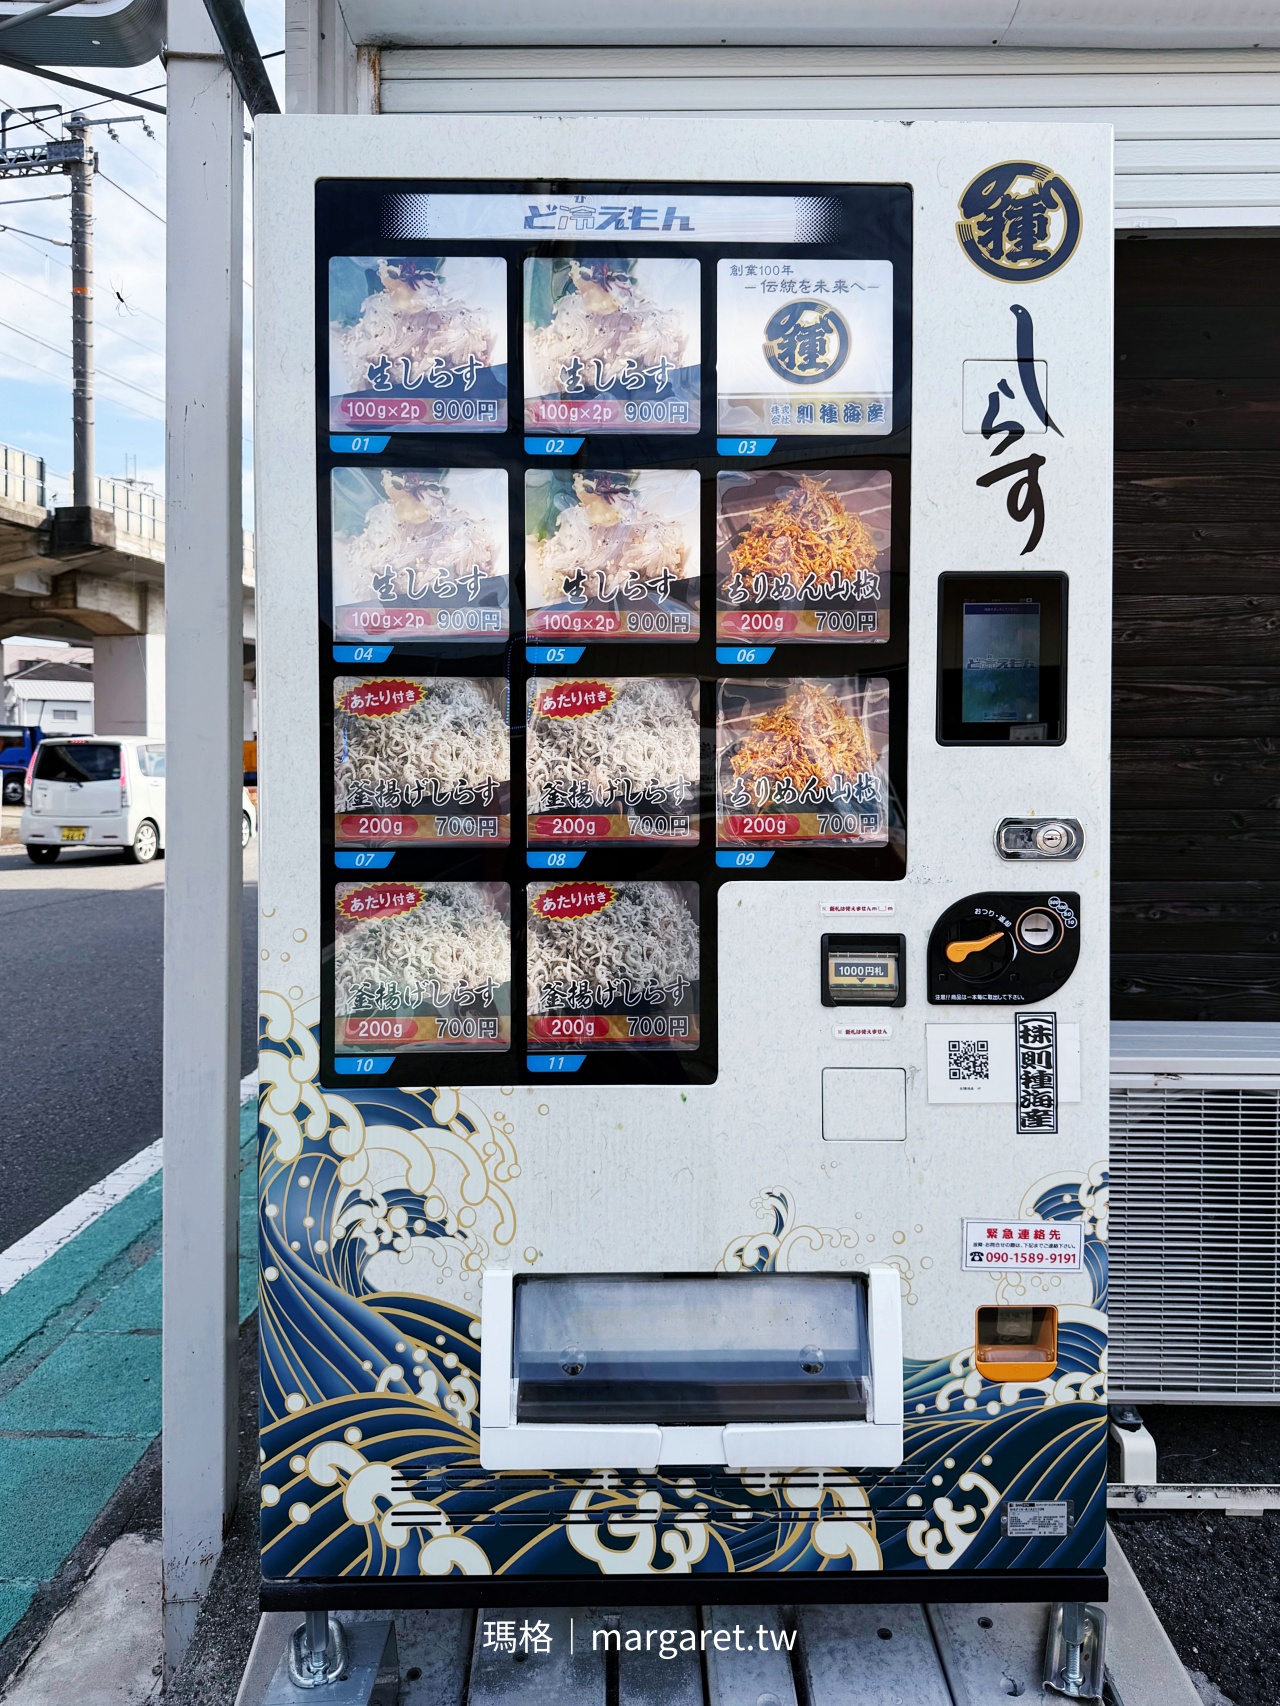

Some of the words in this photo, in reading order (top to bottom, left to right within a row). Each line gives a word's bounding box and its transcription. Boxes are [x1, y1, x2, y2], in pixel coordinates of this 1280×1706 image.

[523, 204, 695, 231] ど冷えもん
[730, 265, 794, 276] 創業100年
[367, 354, 483, 391] 生しらす
[559, 355, 675, 393] 生しらす
[347, 401, 420, 419] 100g×2p
[432, 399, 498, 422] 900円
[540, 403, 612, 422] 100g×2p
[624, 401, 689, 423] 900円
[796, 402, 885, 424] 則種海産
[976, 303, 1065, 556] しらす
[351, 437, 369, 451] 01
[545, 439, 565, 453] 02
[738, 440, 757, 454] 03
[371, 565, 488, 602] 生しらす
[562, 567, 678, 605] 生しらす
[728, 568, 881, 603] ちりめん山椒
[352, 612, 425, 629] 100g×2p
[436, 609, 502, 632] 900円
[543, 614, 615, 631] 100g×2p
[627, 612, 690, 633] 900円
[740, 614, 784, 631] 200g
[815, 611, 878, 633] 700円
[354, 647, 373, 661] 04
[546, 649, 566, 662] 05
[736, 649, 756, 662] 06
[350, 689, 416, 709] あたり付き
[542, 691, 607, 711] あたり付き
[347, 776, 501, 808] 釜揚げしらす
[540, 775, 692, 808] 釜揚げしらす
[730, 772, 882, 807] ちりめん山椒
[359, 817, 403, 835] 200g
[434, 816, 499, 837] 700円
[552, 818, 596, 835] 200g
[627, 815, 690, 836] 700円
[743, 817, 786, 834] 200g
[816, 813, 881, 834] 700円
[355, 854, 375, 867] 07
[547, 853, 567, 866] 08
[735, 852, 755, 866] 09
[350, 892, 416, 912] あたり付き
[542, 892, 607, 911] あたり付き
[839, 966, 884, 976] 1000円札
[348, 976, 501, 1011] 釜揚げしらす
[539, 975, 690, 1009] 釜揚げしらす
[358, 1021, 403, 1038] 200g
[434, 1017, 499, 1038] 700円
[551, 1019, 595, 1036] 200g
[626, 1016, 689, 1037] 700円
[355, 1059, 374, 1072] 10
[548, 1057, 565, 1070] 11
[986, 1228, 1061, 1240] 緊急連絡先
[986, 1252, 1076, 1264] 090-1589-9191
